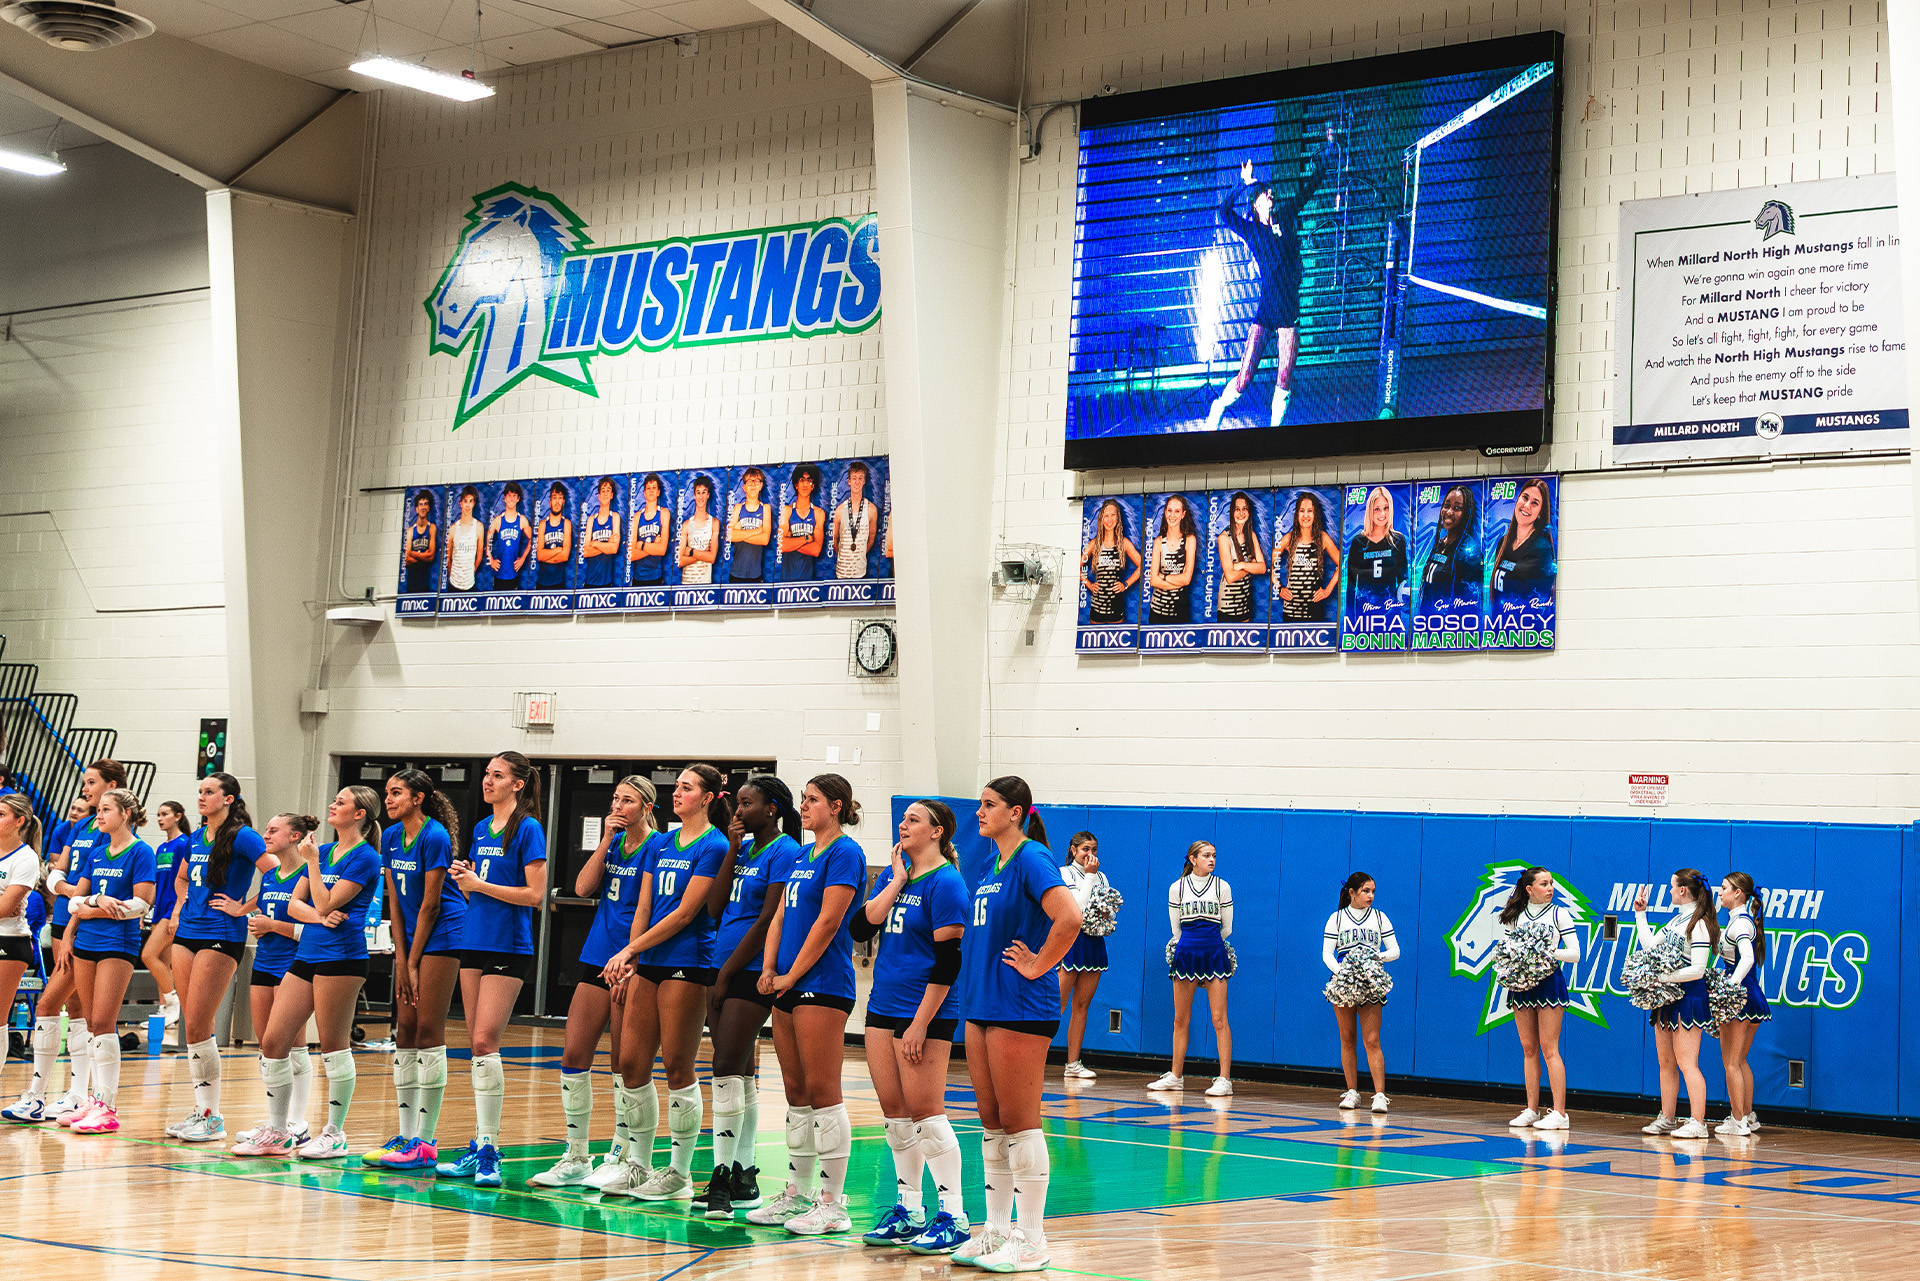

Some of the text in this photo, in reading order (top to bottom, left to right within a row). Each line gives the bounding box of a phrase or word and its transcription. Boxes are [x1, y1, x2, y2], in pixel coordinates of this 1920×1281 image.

[1647, 234, 1900, 268] When Millard North High Mustangs fall in lin
[1684, 260, 1868, 285] We're gonna win again one more time
[545, 219, 882, 352] MUSTANGS
[1682, 296, 1696, 306] For
[1700, 290, 1742, 304] Millard
[1746, 287, 1780, 300] North
[1790, 284, 1816, 296] cheer
[1820, 282, 1833, 294] for
[1836, 282, 1869, 293] victory
[1685, 313, 1703, 325] And
[1707, 316, 1714, 324] a
[1718, 308, 1779, 323] MUSTANG
[1789, 308, 1803, 316] am
[1807, 302, 1835, 318] proud
[1840, 304, 1848, 312] to
[1852, 300, 1864, 312] be
[1672, 324, 1877, 347] So let's all fight, fight, fight, for every game
[1645, 339, 1906, 369] And watch the North High Mustangs rise to fame
[1691, 363, 1856, 387] And push the enemy off to the side
[1693, 384, 1853, 406] Let's keep that MUSTANG pride
[1654, 422, 1740, 437] MILLARD NORTH
[1816, 414, 1880, 427] MUSTANGS
[1348, 487, 1367, 505] #6
[1420, 486, 1441, 503] #11
[1491, 482, 1516, 500] #16
[1373, 560, 1383, 578] 6
[1426, 563, 1437, 584] 11
[1143, 569, 1152, 603] LYDIA
[1494, 570, 1506, 592] 16
[1204, 574, 1214, 618] ALAINA
[1344, 615, 1406, 632] MIRA
[1413, 615, 1479, 631] SOSO
[1484, 614, 1554, 630] MACY
[1342, 632, 1406, 650] BONIN
[1412, 632, 1480, 649] MARIN
[1482, 630, 1554, 647] RANDS
[529, 701, 548, 720] EXIT
[1631, 776, 1666, 784] WARNING
[70, 850, 80, 871] 2
[480, 859, 490, 881] 8
[657, 859, 691, 870] MUSTANGS
[92, 868, 124, 877] MUSTANGS
[191, 864, 202, 886] 4
[99, 879, 108, 895] 3
[397, 873, 406, 896] 7
[608, 878, 621, 901] 9
[658, 871, 676, 896] 10
[730, 878, 744, 902] 11
[785, 881, 800, 908] 14
[267, 903, 276, 920] 5
[885, 907, 907, 934] 15
[973, 897, 988, 926] 16
[1339, 928, 1379, 945] STANGS
